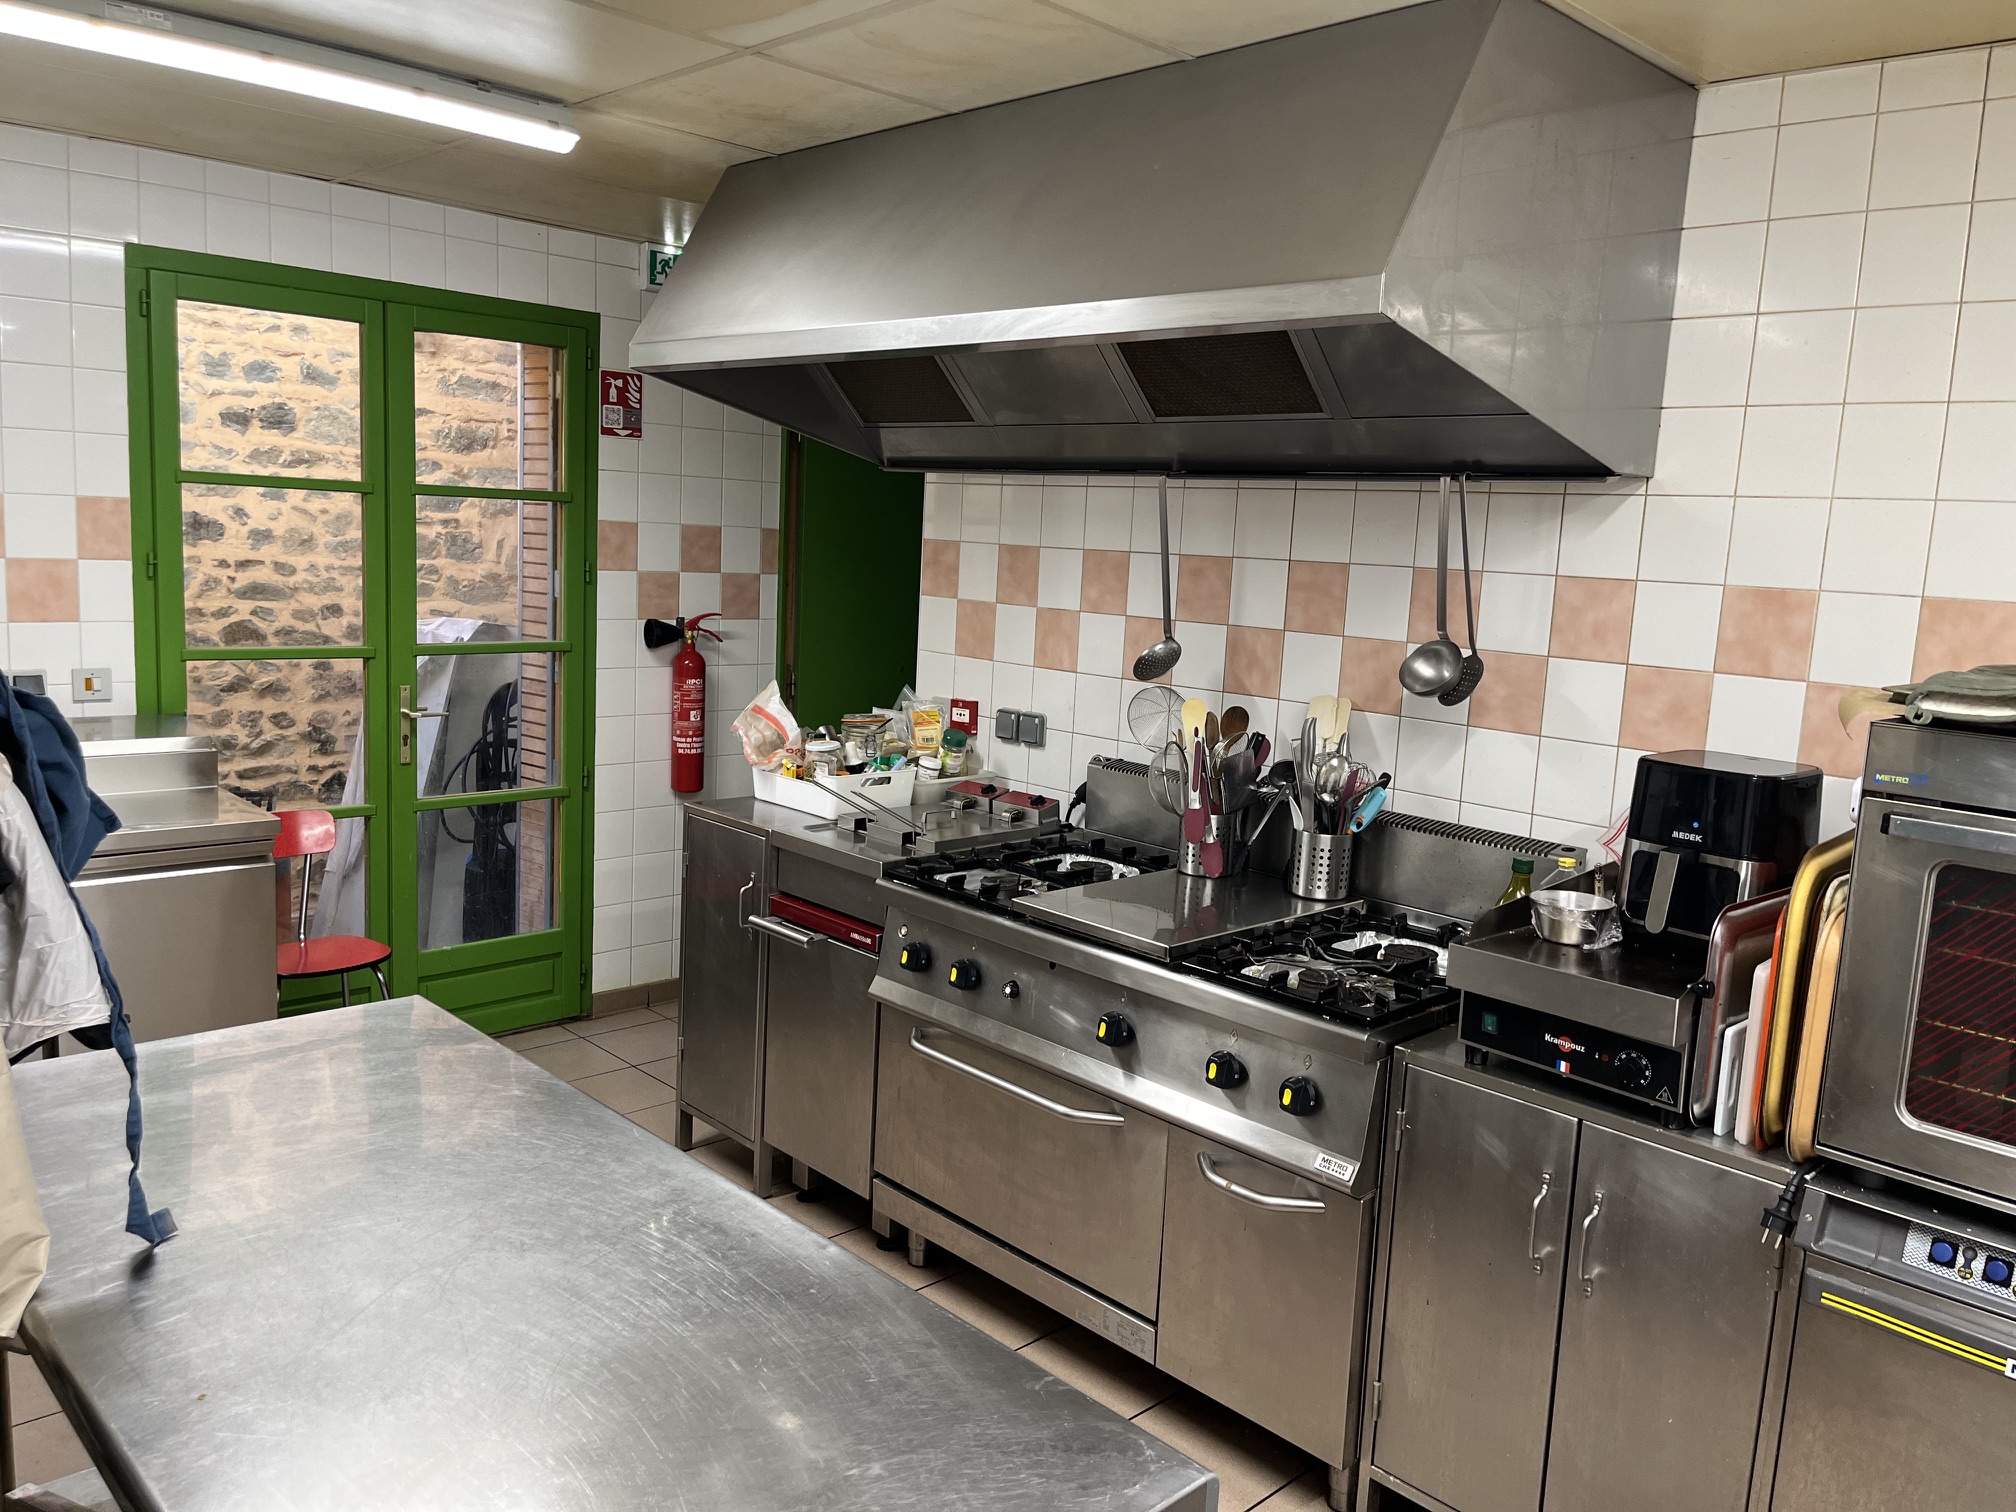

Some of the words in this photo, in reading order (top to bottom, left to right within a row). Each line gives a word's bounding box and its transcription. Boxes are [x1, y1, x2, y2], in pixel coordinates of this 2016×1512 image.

[1875, 773, 1910, 784] METRO
[1544, 1032, 1586, 1053] Krampouz
[1321, 1156, 1348, 1172] METRO
